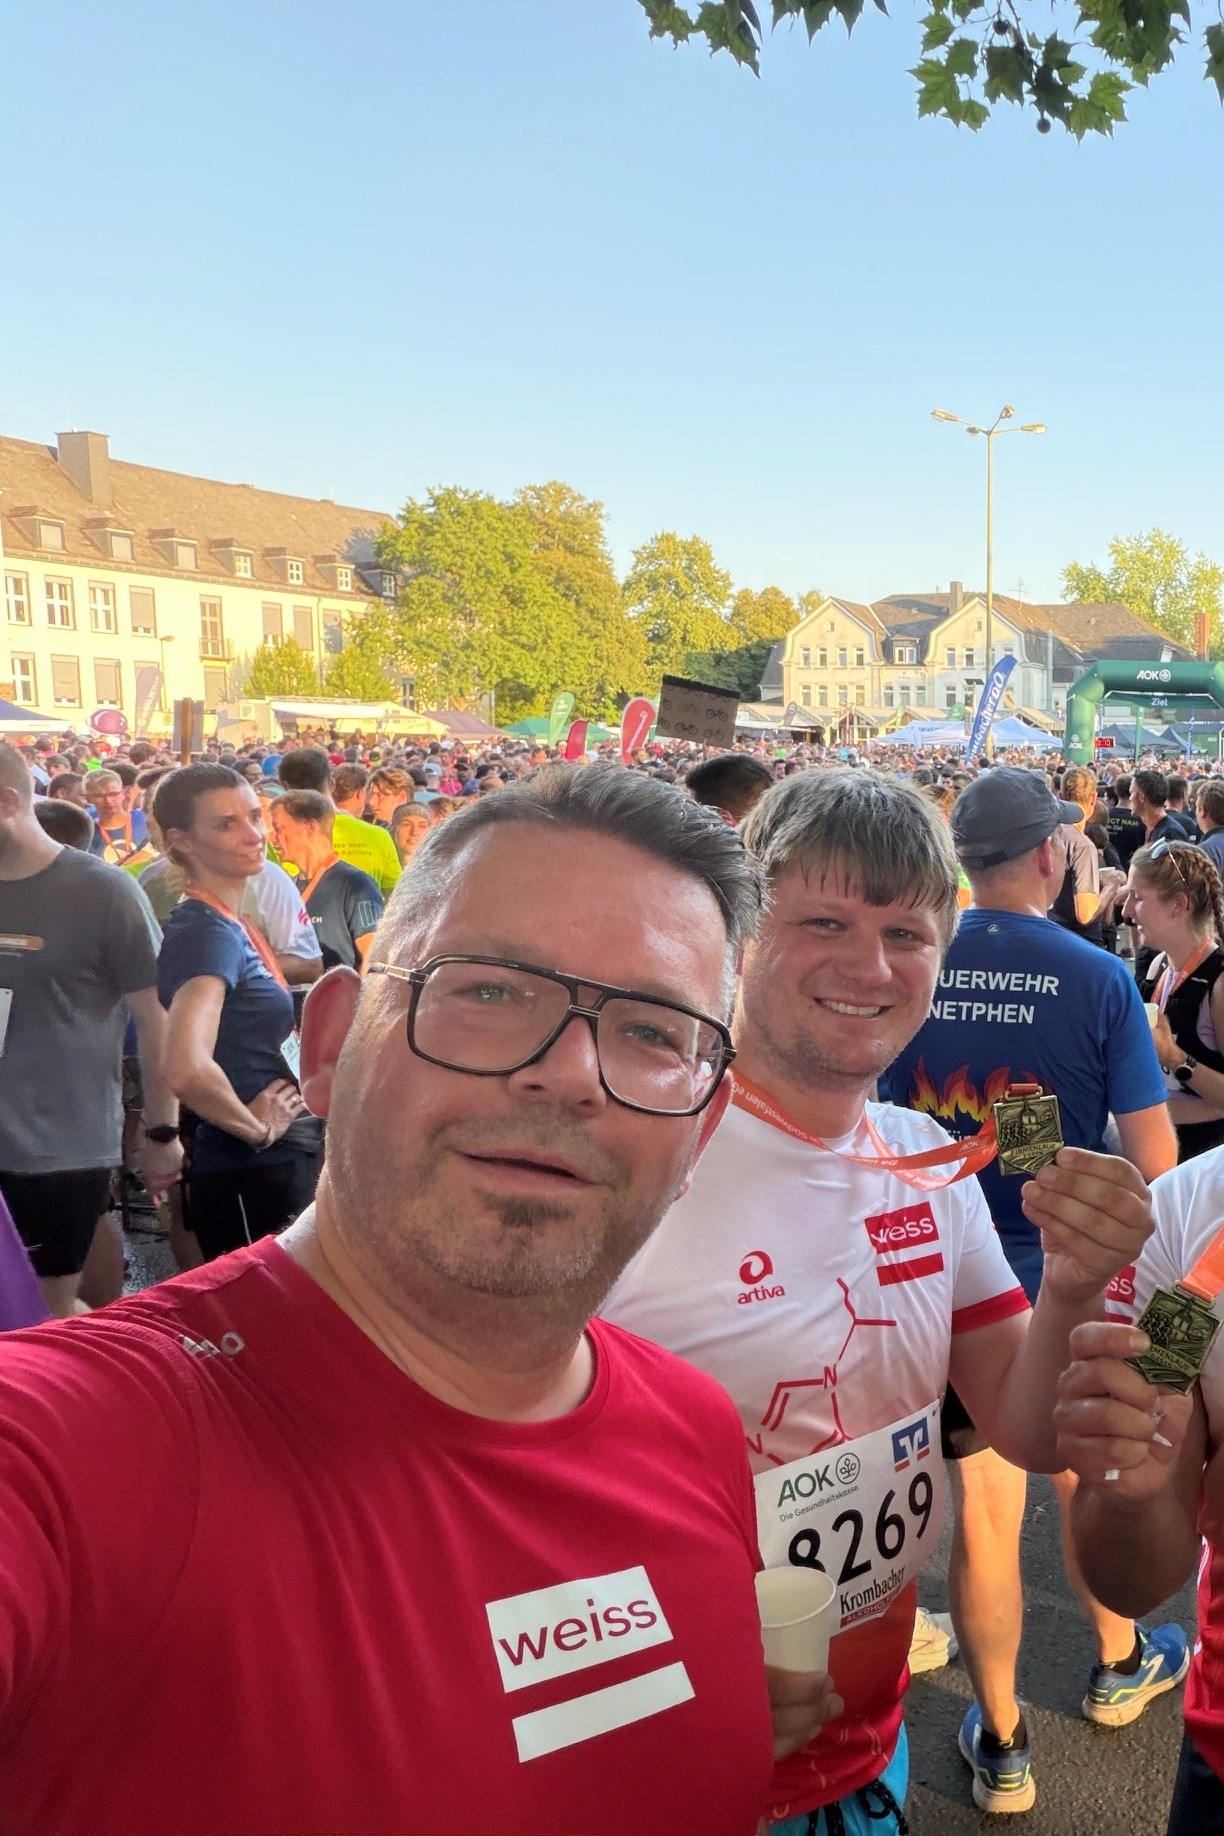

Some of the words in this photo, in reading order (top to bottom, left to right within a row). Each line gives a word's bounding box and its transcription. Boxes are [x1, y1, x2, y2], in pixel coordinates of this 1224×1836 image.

[1136, 670, 1159, 680] AOK
[1151, 698, 1168, 707] Ziel
[1069, 742, 1083, 750] AOK
[940, 969, 1060, 996] UERWEHR
[928, 1001, 1035, 1024] NETPHEN
[871, 1216, 934, 1245] wess
[737, 1285, 786, 1305] artiva
[777, 1464, 835, 1508] AOK
[780, 1512, 794, 1523] Die
[794, 1485, 860, 1517] Gesundheitskasse.
[788, 1471, 933, 1586] 8269
[840, 1566, 906, 1615] Krombacher
[498, 1598, 658, 1667] weiss
